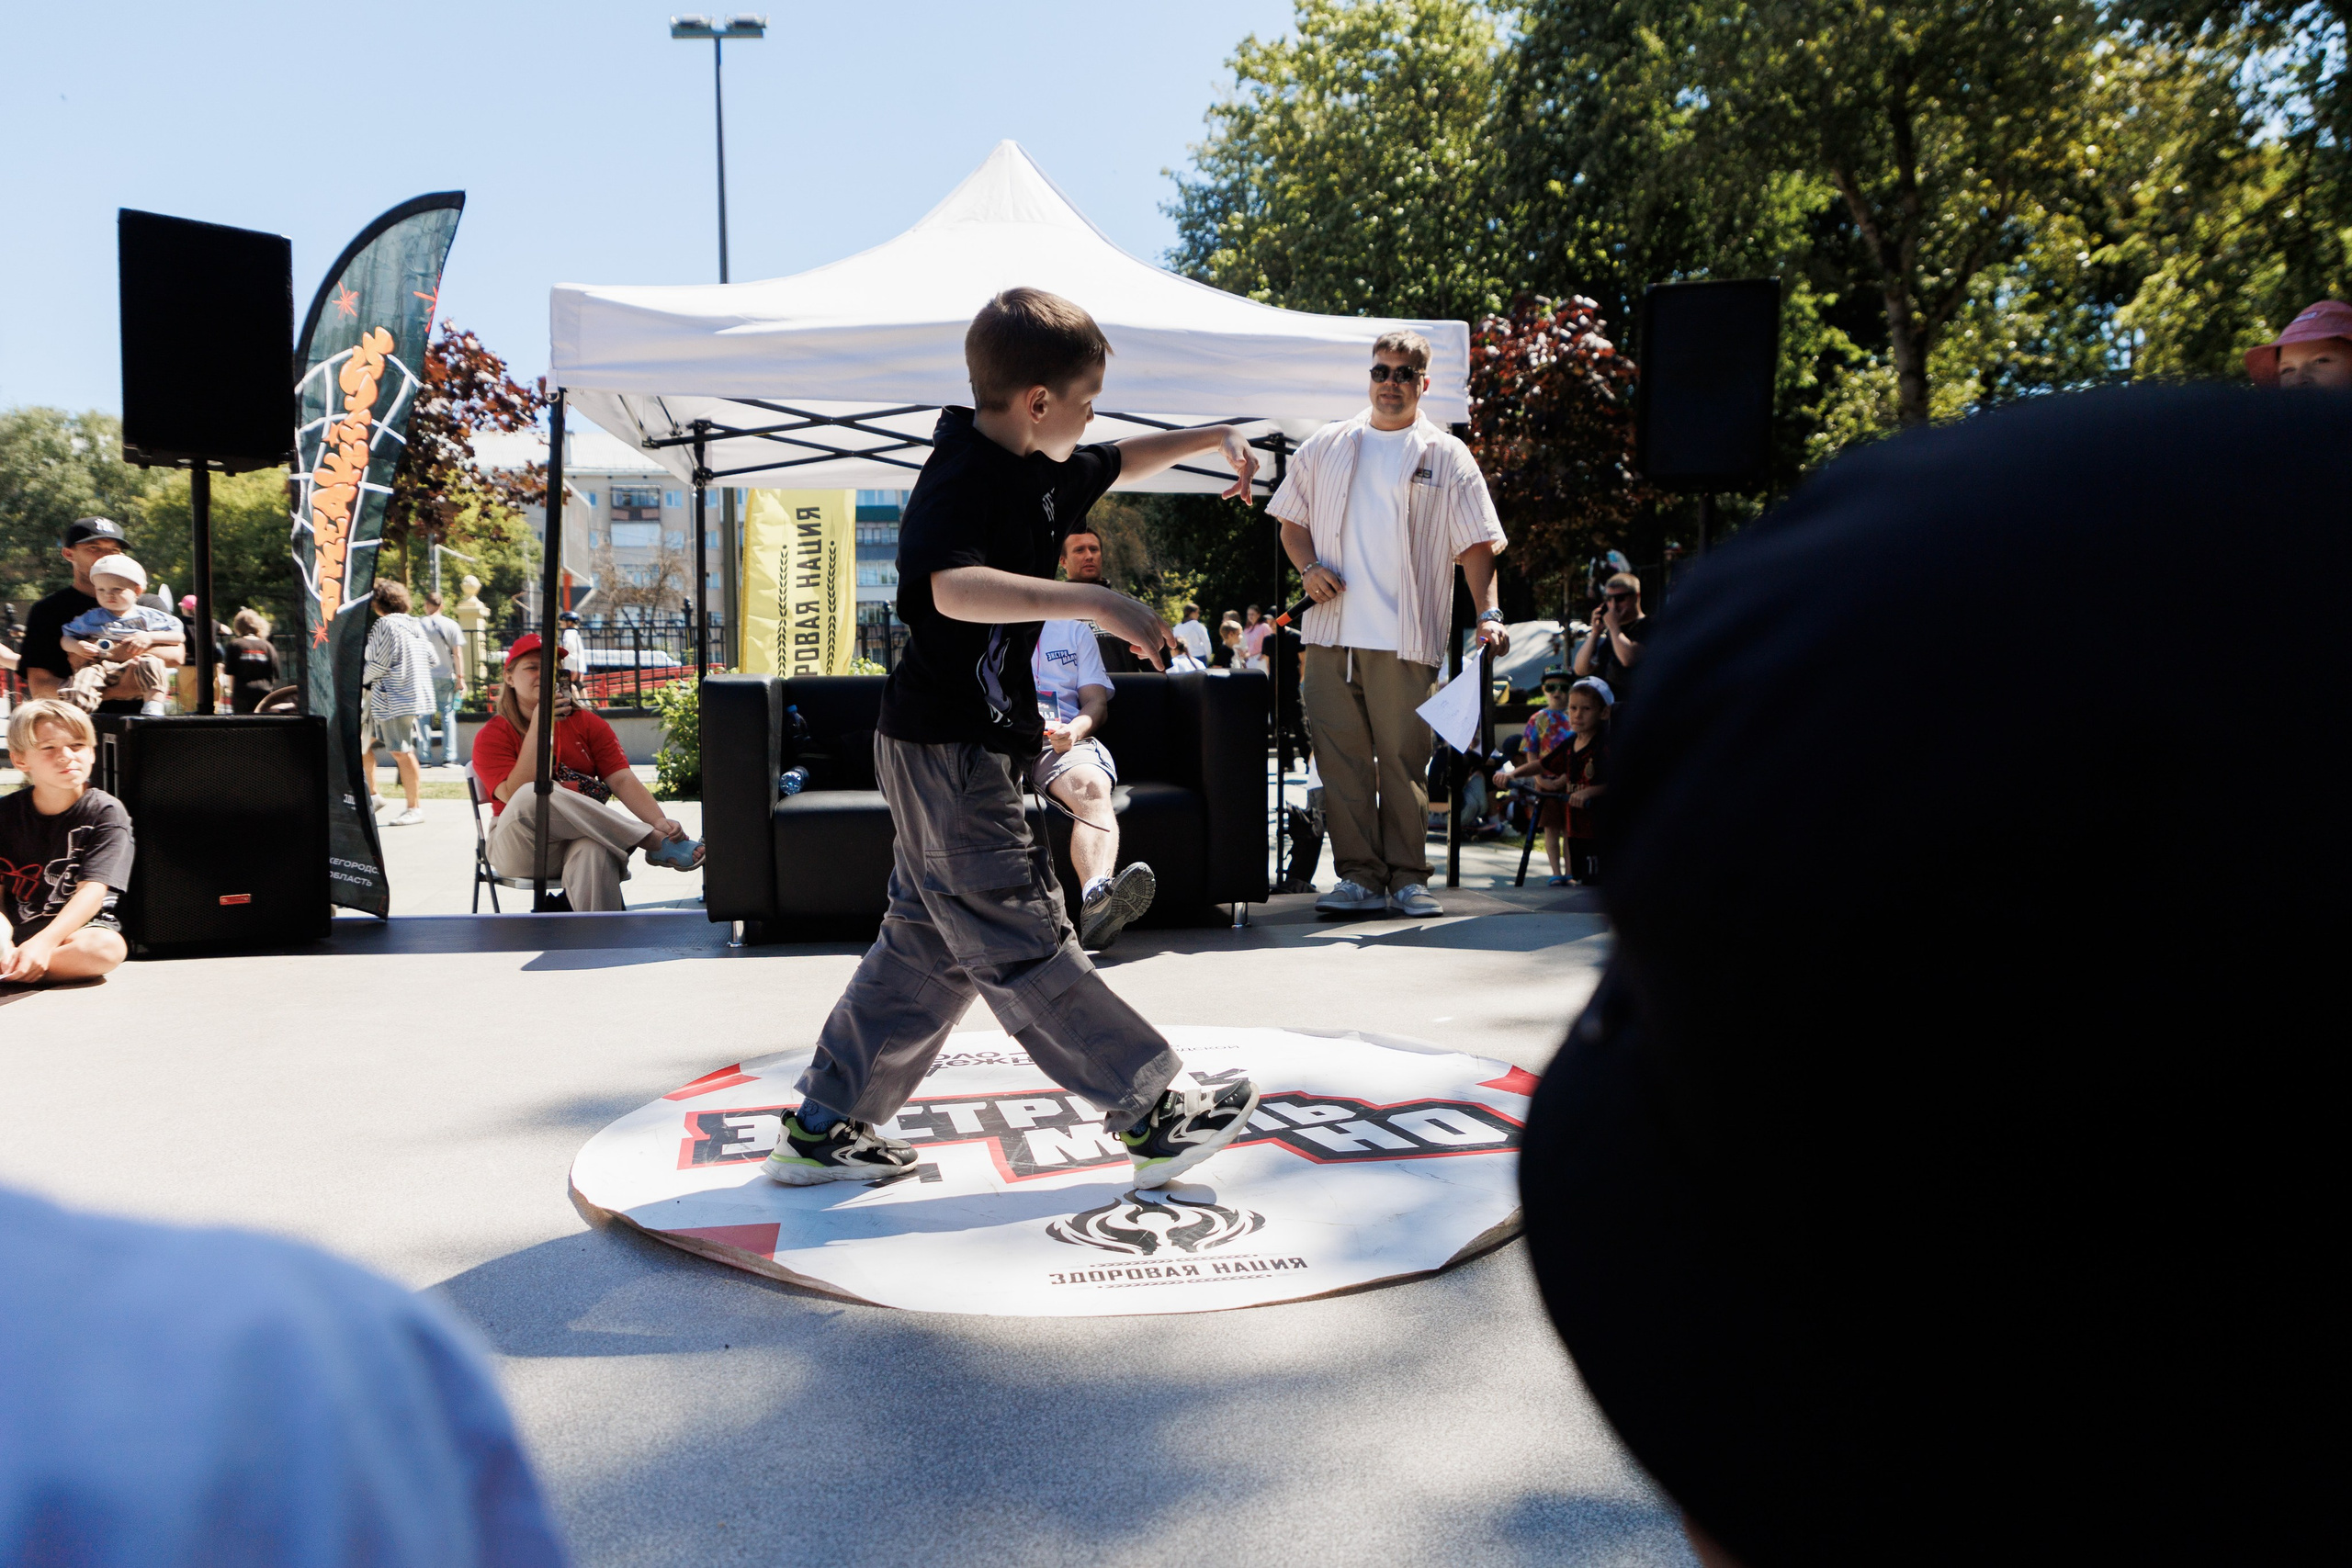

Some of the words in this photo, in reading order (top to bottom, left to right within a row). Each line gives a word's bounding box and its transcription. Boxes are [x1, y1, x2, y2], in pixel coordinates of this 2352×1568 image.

[796, 506, 822, 588] НАЦИЯ
[1048, 1265, 1200, 1285] ЗДОРОВАЯ
[1212, 1258, 1308, 1274] НАЦИЯ
